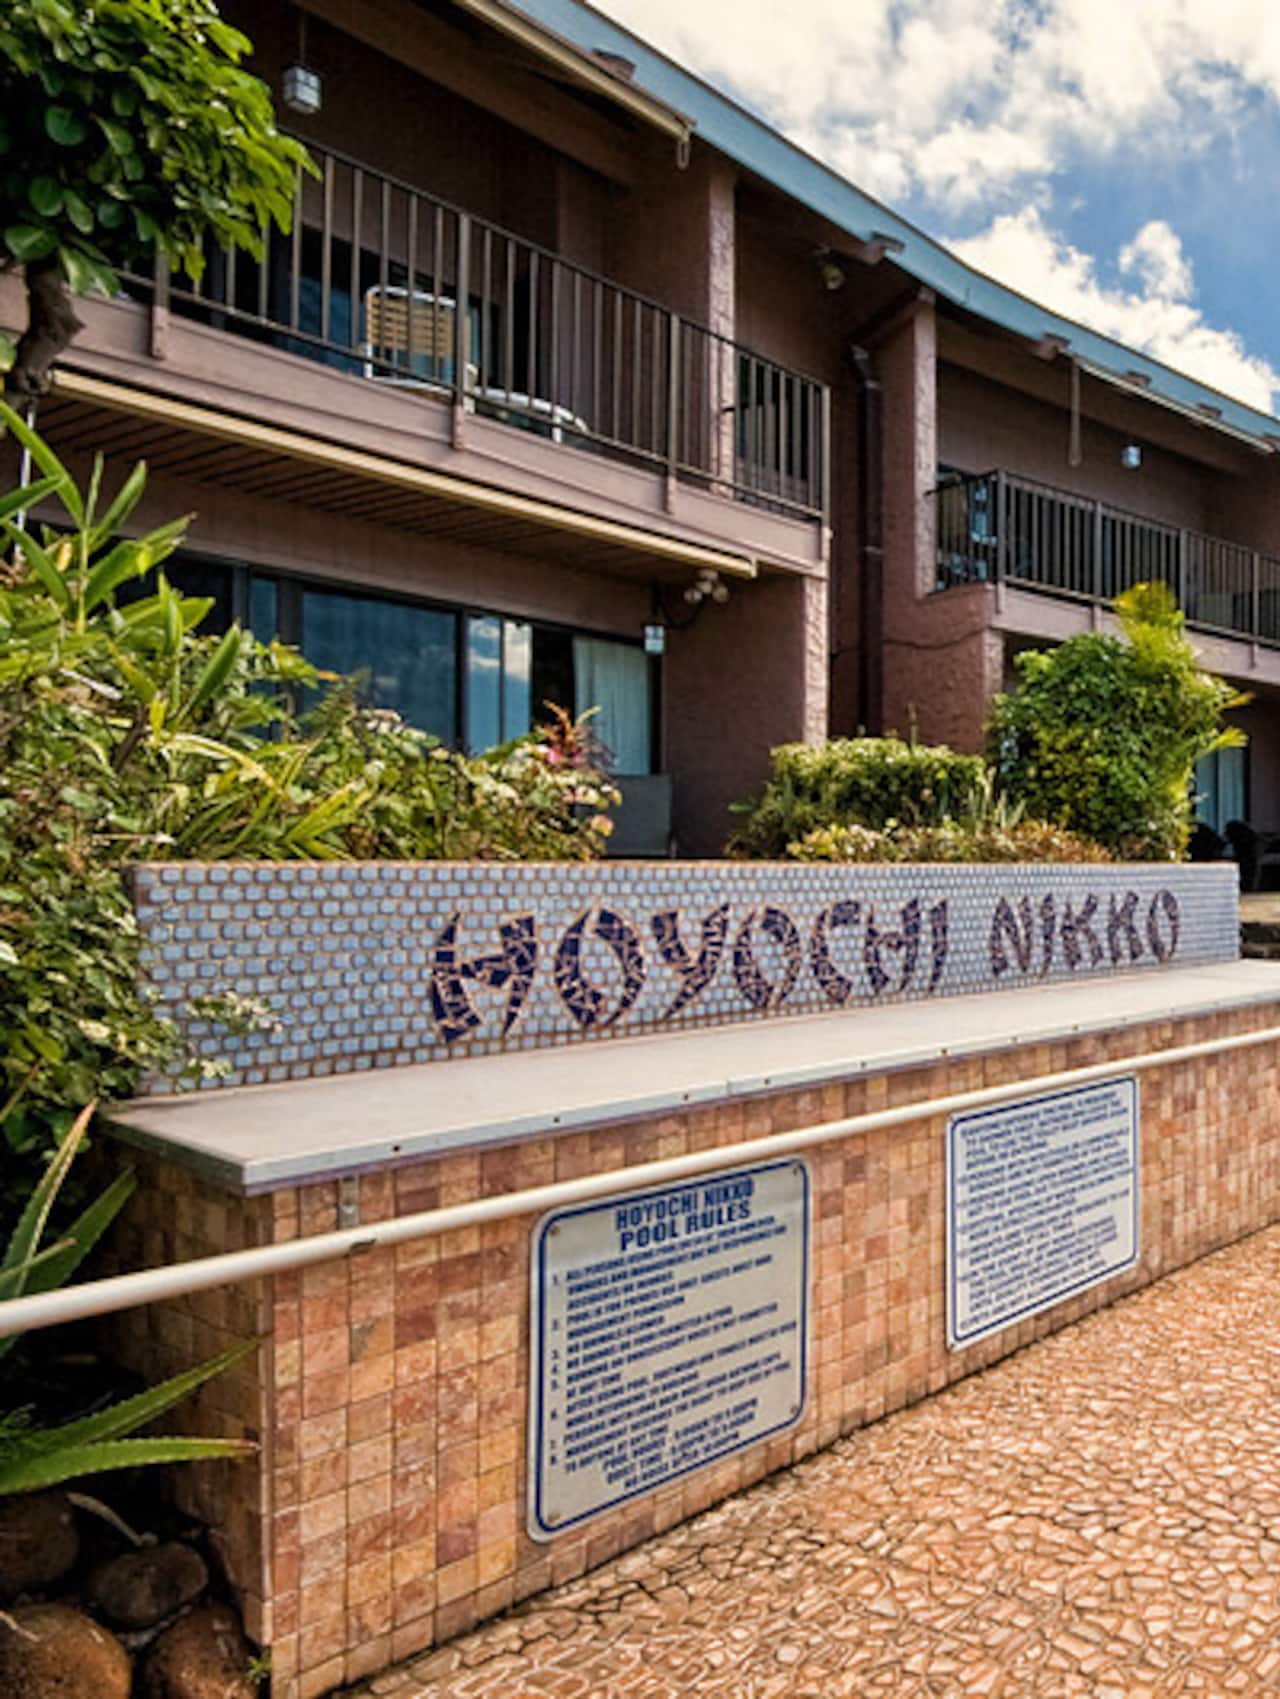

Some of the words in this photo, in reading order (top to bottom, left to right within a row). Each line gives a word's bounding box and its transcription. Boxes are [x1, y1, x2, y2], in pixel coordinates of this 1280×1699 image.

[431, 899, 950, 1043] HOYOCHI
[989, 889, 1180, 979] NIKKO
[620, 1217, 679, 1251] POOL
[685, 1199, 751, 1235] RULES
